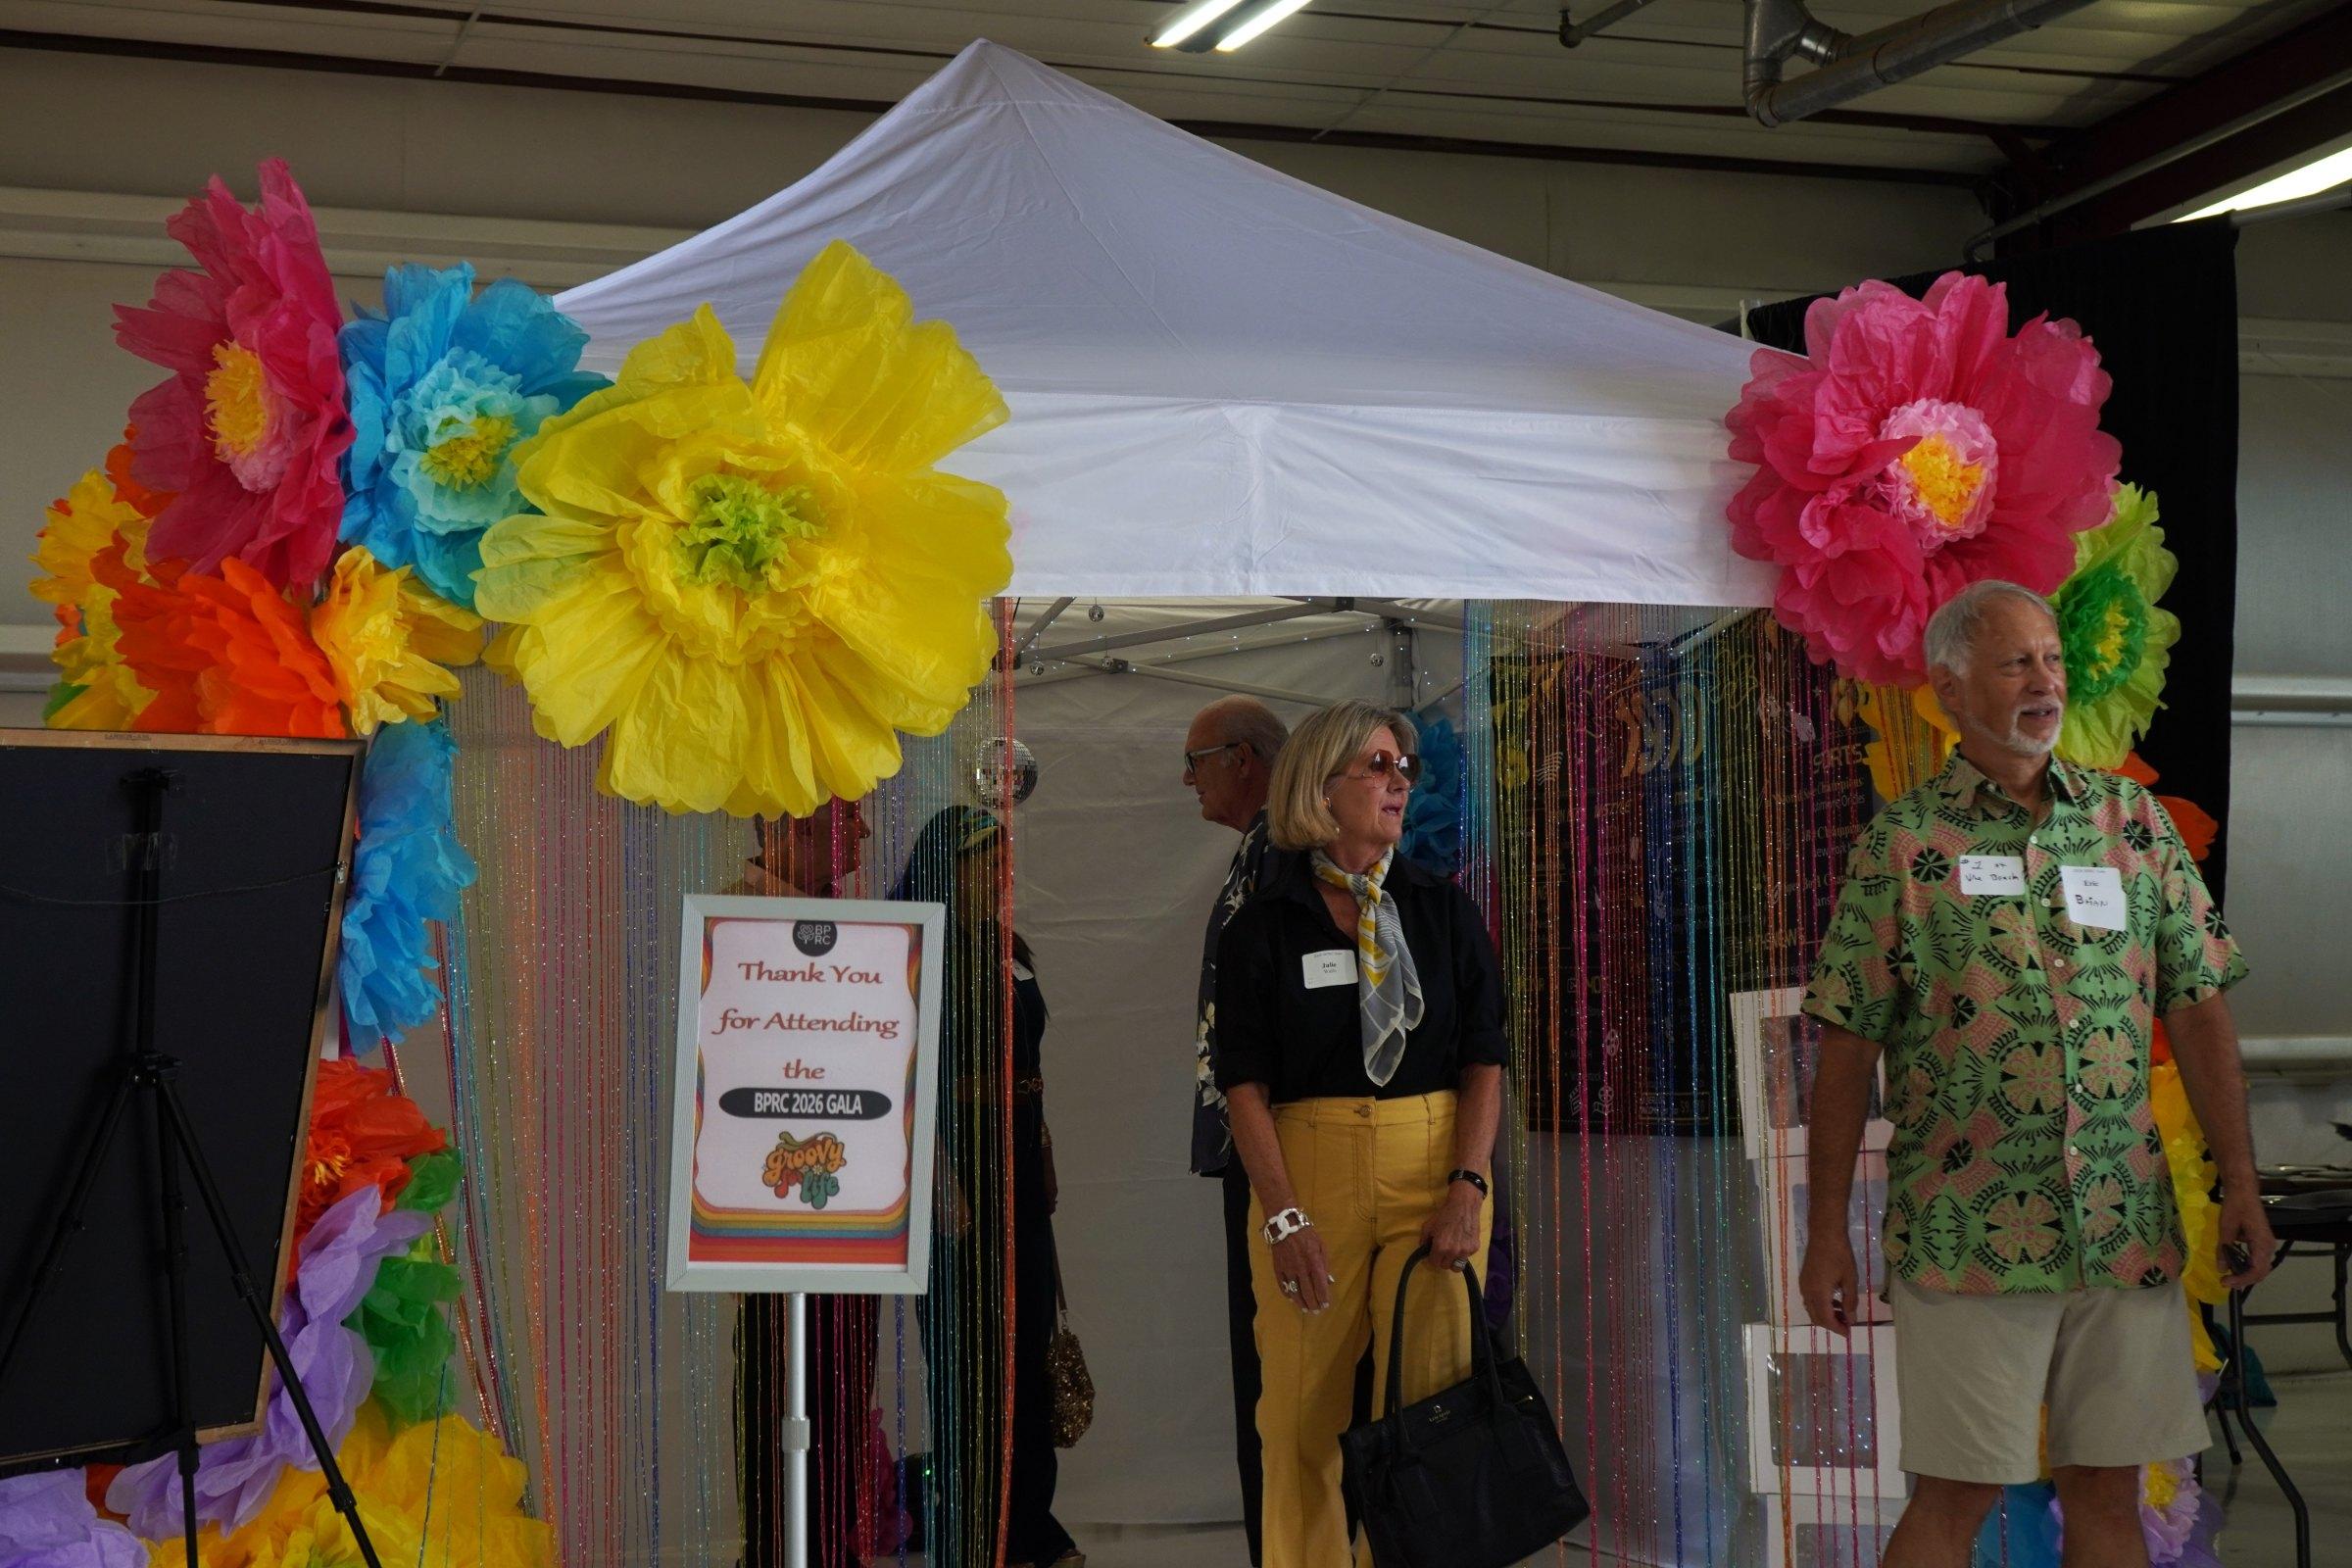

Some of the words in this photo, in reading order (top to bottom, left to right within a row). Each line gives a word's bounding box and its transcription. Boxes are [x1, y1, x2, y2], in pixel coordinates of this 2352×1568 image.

[814, 924, 831, 935] BP
[814, 935, 831, 945] RC
[737, 960, 826, 983] Thank
[829, 965, 884, 984] You
[711, 1008, 760, 1036] for
[762, 1011, 901, 1040] Attending
[782, 1058, 826, 1079] the
[754, 1092, 789, 1113] BPRC
[792, 1093, 824, 1114] 2026
[826, 1094, 862, 1115] GALA
[763, 1137, 847, 1187] groovy
